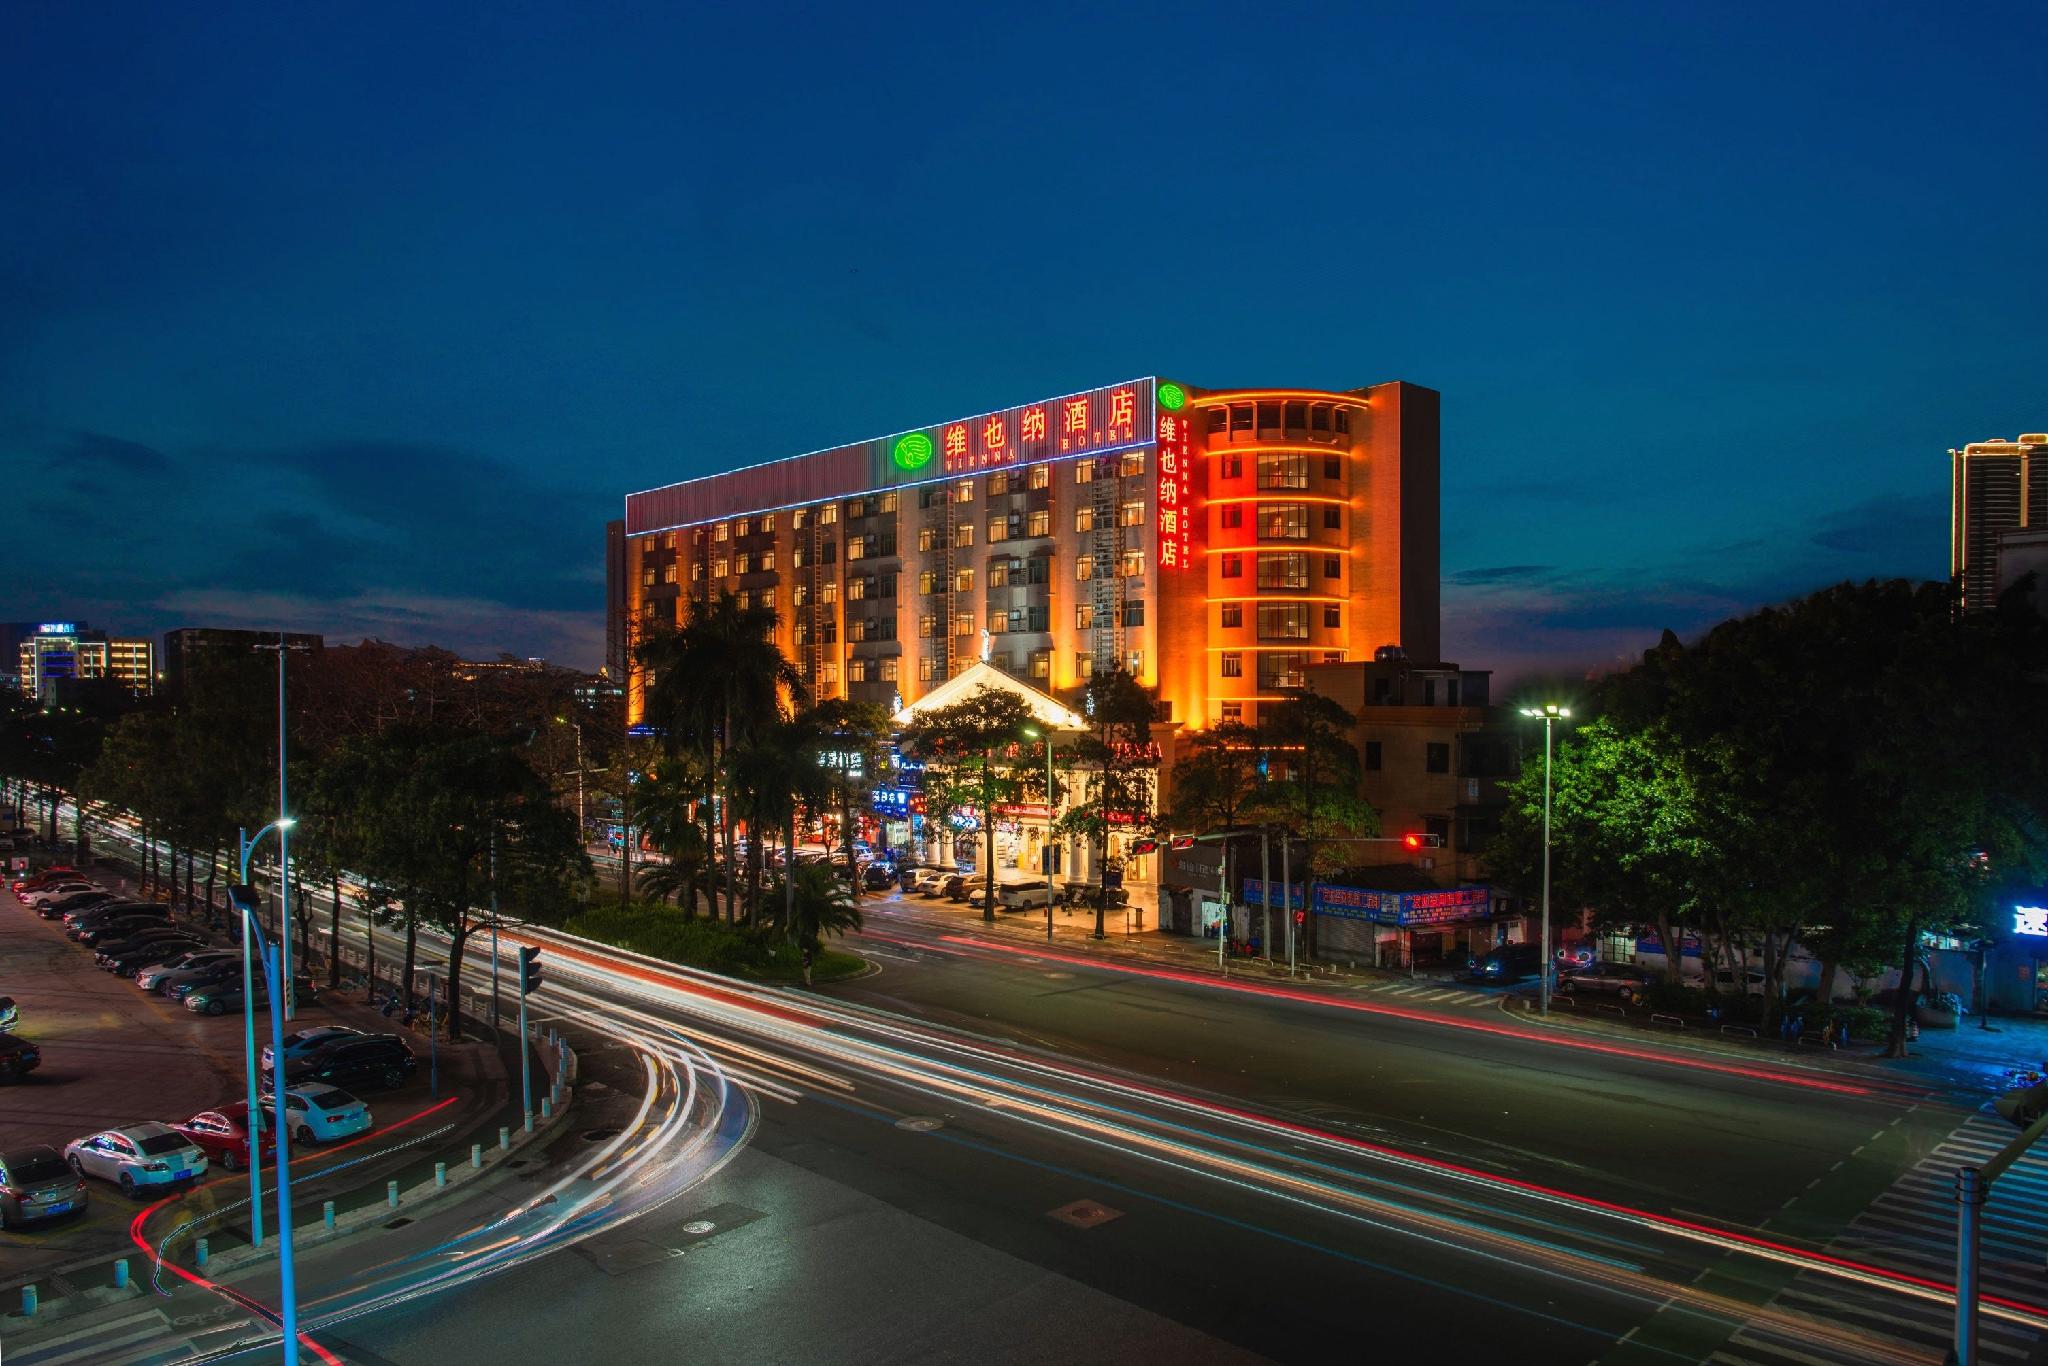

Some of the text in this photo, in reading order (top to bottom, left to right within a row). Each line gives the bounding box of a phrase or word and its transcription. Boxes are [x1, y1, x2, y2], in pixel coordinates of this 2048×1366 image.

[946, 389, 1134, 456] 维也纳酒店
[946, 427, 1132, 471] VIENNA HOTEL
[1160, 416, 1177, 566] 维也纳酒店
